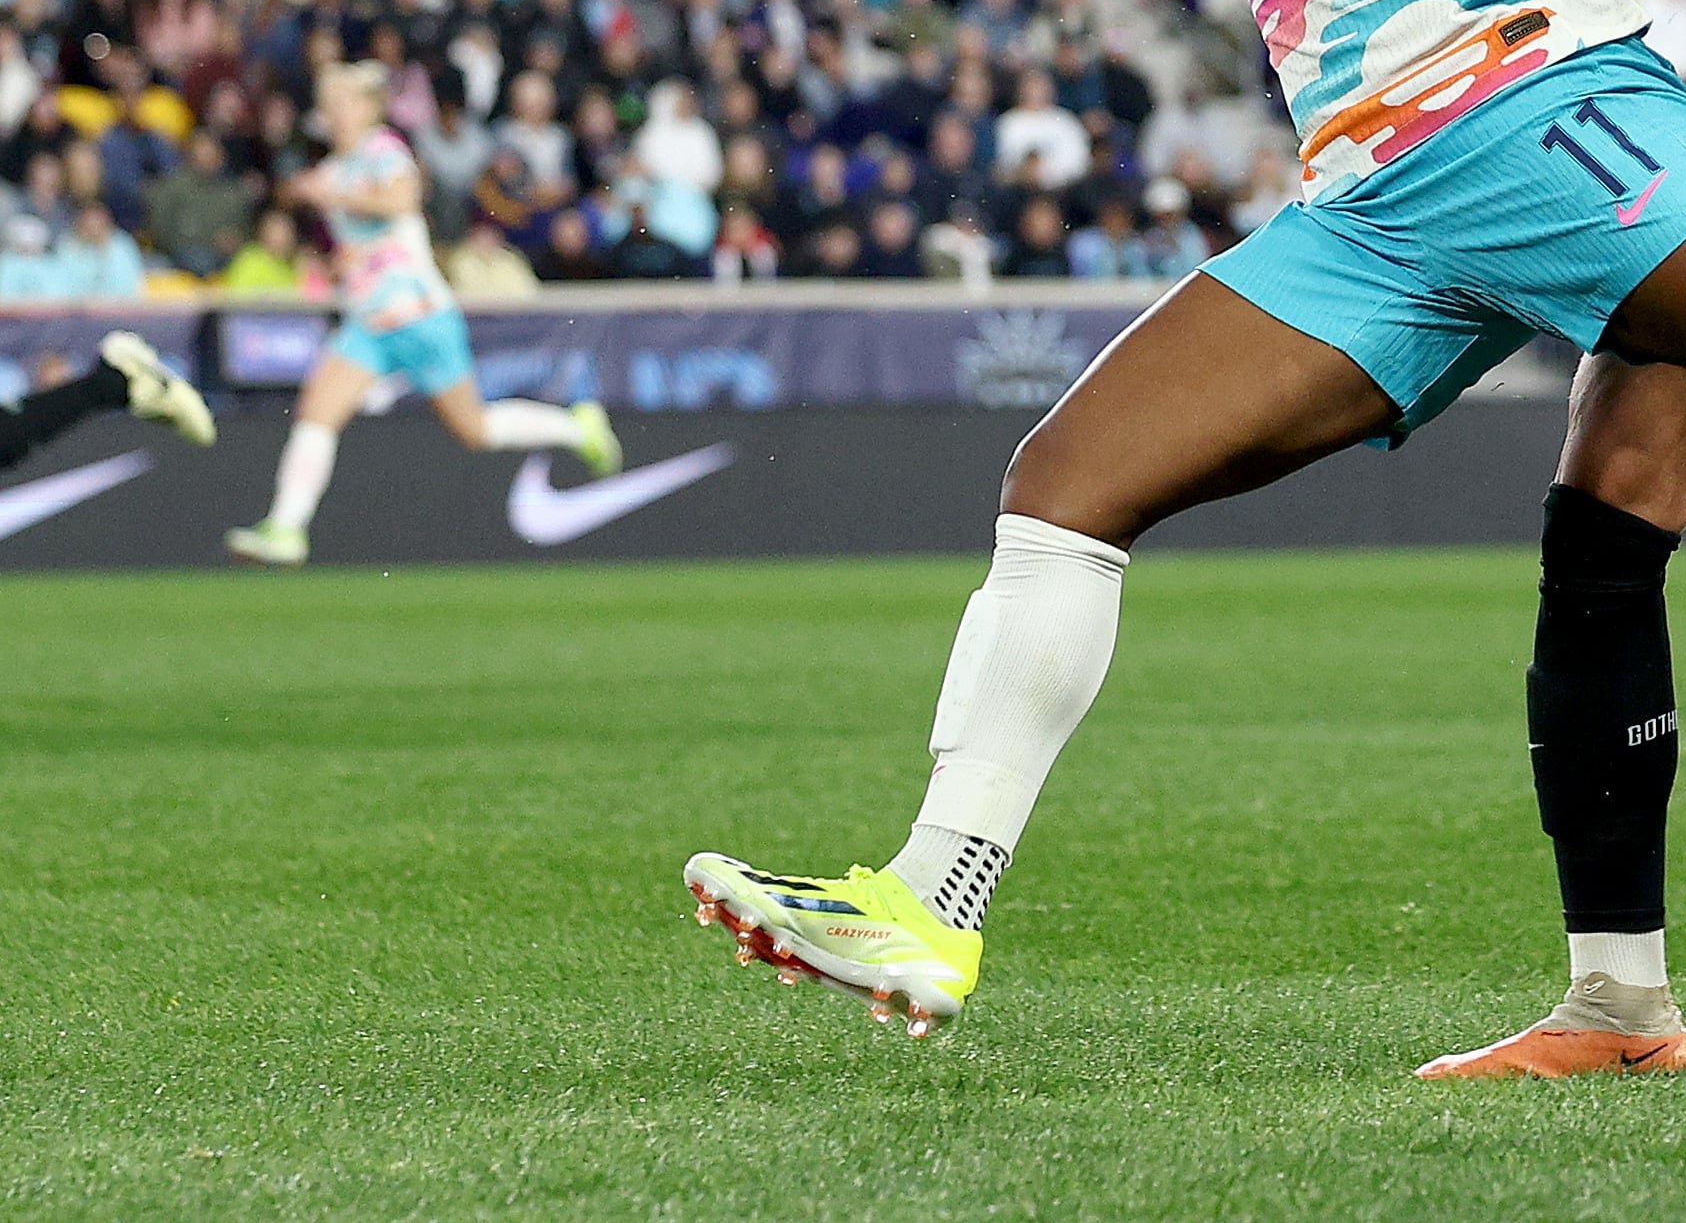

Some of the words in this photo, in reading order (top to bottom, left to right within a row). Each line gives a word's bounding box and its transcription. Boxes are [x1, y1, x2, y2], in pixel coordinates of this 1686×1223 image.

[1539, 97, 1661, 199] 11
[1627, 710, 1679, 746] GOTH
[826, 927, 892, 939] CRAZYFAST
